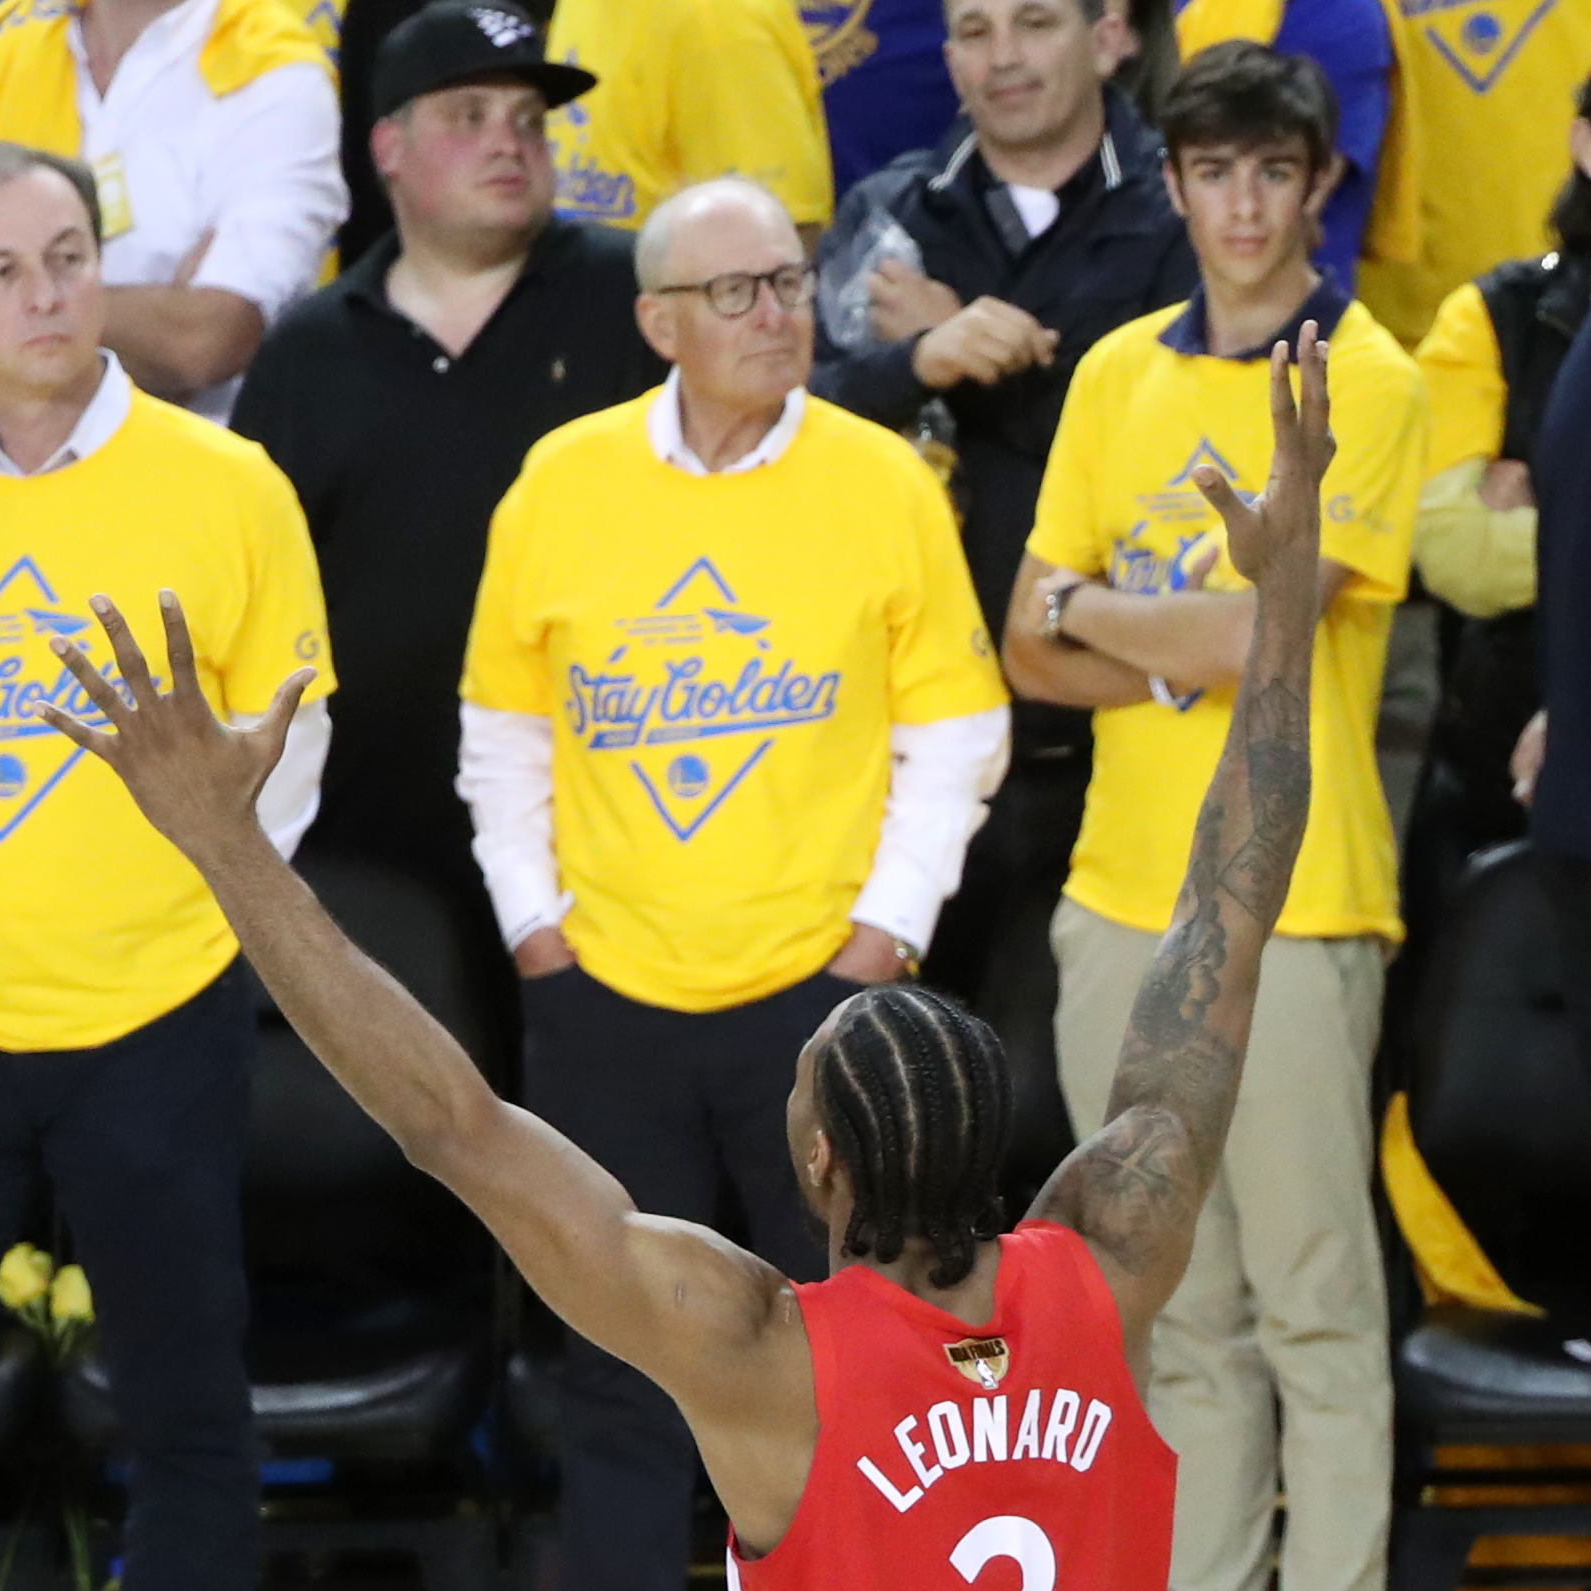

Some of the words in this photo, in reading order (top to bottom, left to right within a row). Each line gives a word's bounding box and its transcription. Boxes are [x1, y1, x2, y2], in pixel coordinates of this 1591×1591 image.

[566, 663, 661, 746] Stay
[659, 655, 842, 720] Golden
[856, 1388, 1113, 1514] LEONARD
